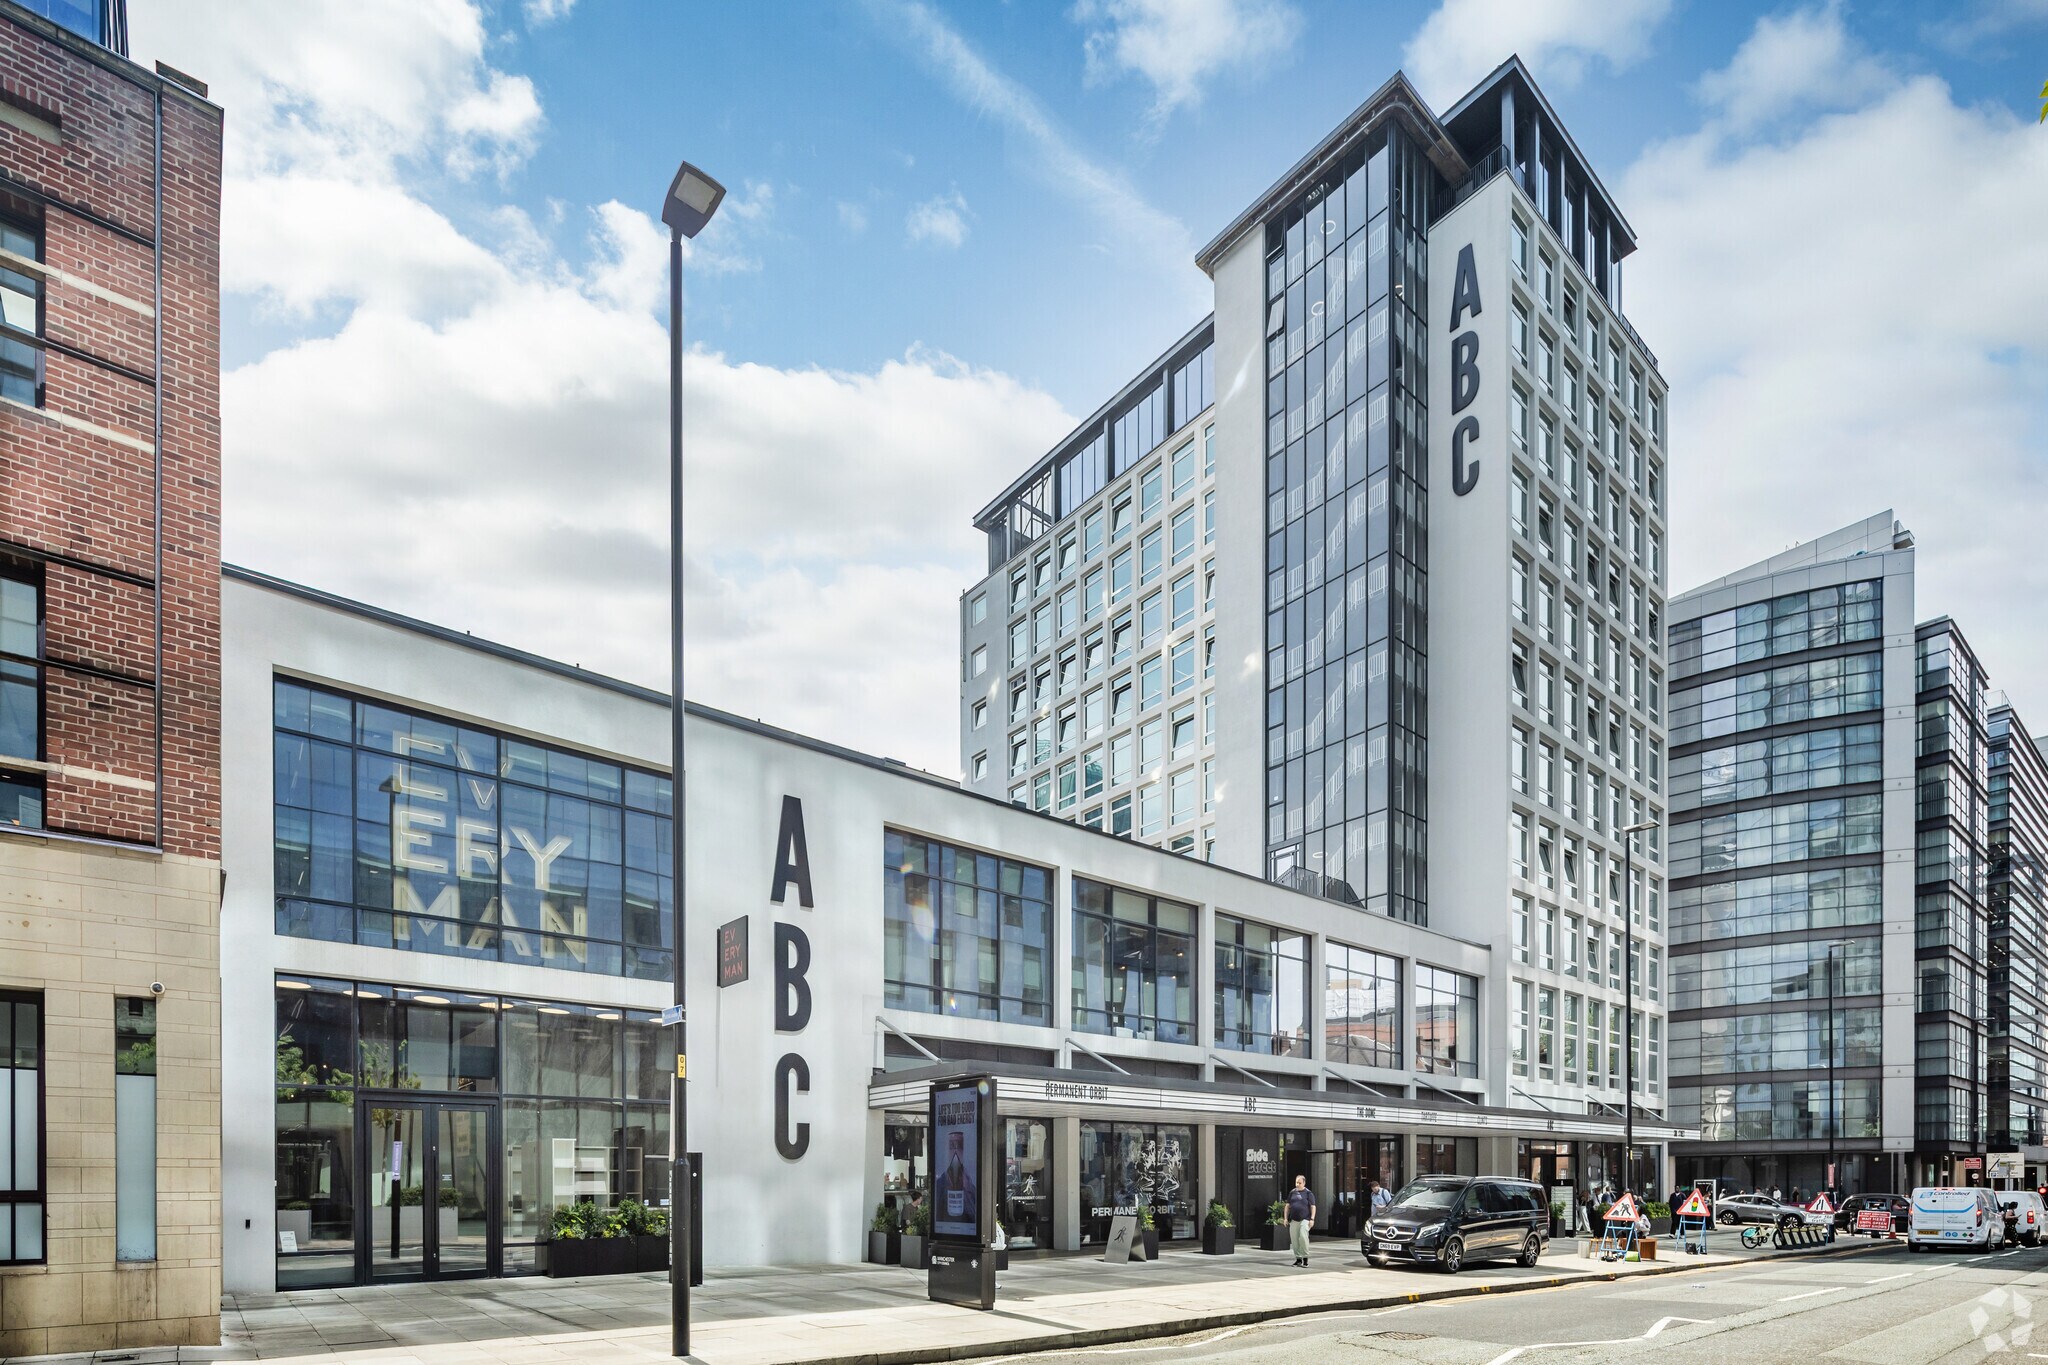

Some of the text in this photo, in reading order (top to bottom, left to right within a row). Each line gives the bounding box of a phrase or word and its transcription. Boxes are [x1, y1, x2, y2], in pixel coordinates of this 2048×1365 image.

[1449, 243, 1482, 497] ABC
[392, 730, 515, 811] EV
[392, 803, 573, 891] ERY
[393, 874, 588, 964] MAN
[724, 927, 736, 944] EV
[724, 943, 741, 962] ERY
[724, 960, 743, 979] MAN
[770, 794, 815, 1161] ABC
[1045, 1082, 1108, 1100] PERMANENT ORBIT
[1243, 1097, 1257, 1112] ABC
